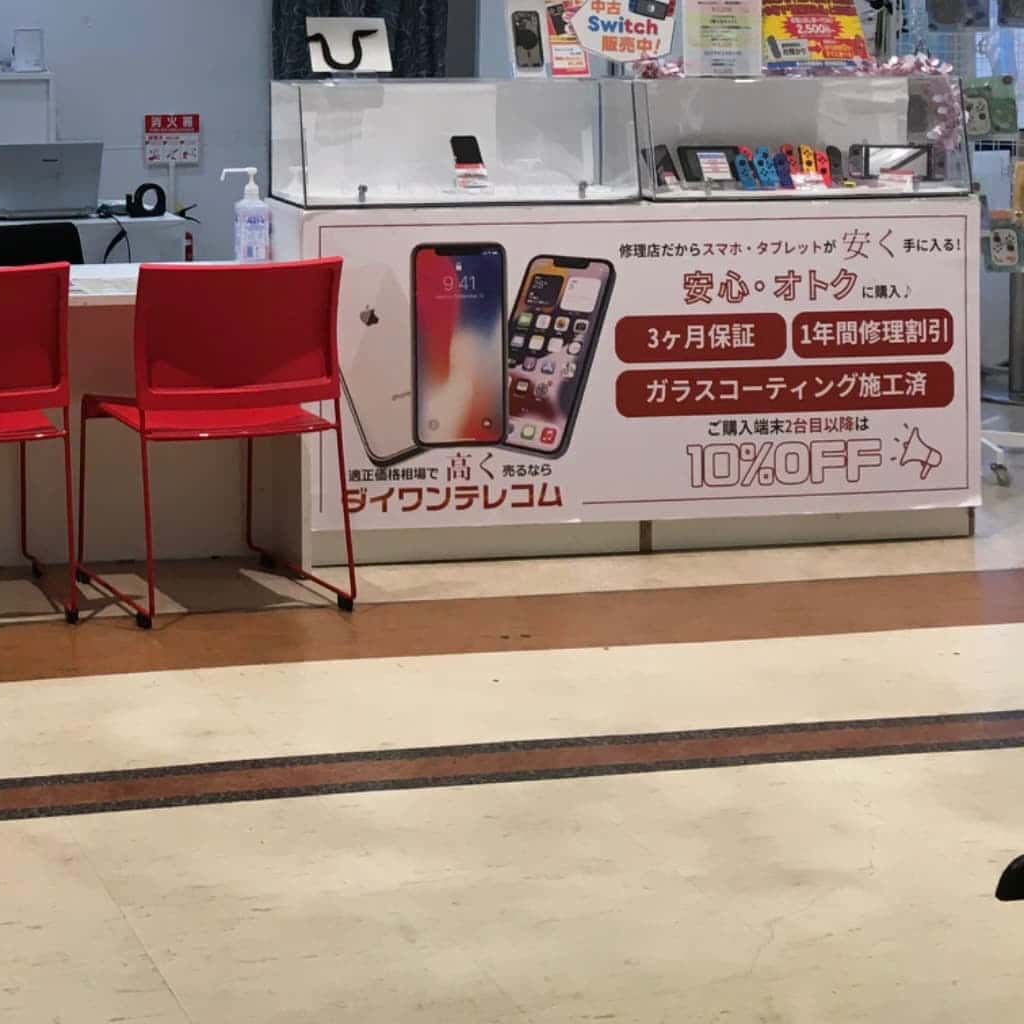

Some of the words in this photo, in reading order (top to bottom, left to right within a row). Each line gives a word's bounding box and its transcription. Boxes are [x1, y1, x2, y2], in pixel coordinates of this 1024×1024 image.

[590, 0, 637, 16] 中古
[587, 16, 659, 35] Switch
[601, 35, 662, 55] 販売中!
[842, 228, 896, 261] 安く
[442, 275, 477, 292] 941
[683, 268, 859, 305] 安心・オトク
[800, 318, 949, 346] 1年間修理割引
[646, 372, 929, 404] ガラスコーティング施工済
[707, 415, 870, 437] ご購入端末2台目以降は
[502, 463, 553, 478] 売るなら
[687, 438, 883, 489] 10%OFF
[345, 481, 563, 513] ダイワンテレコム
